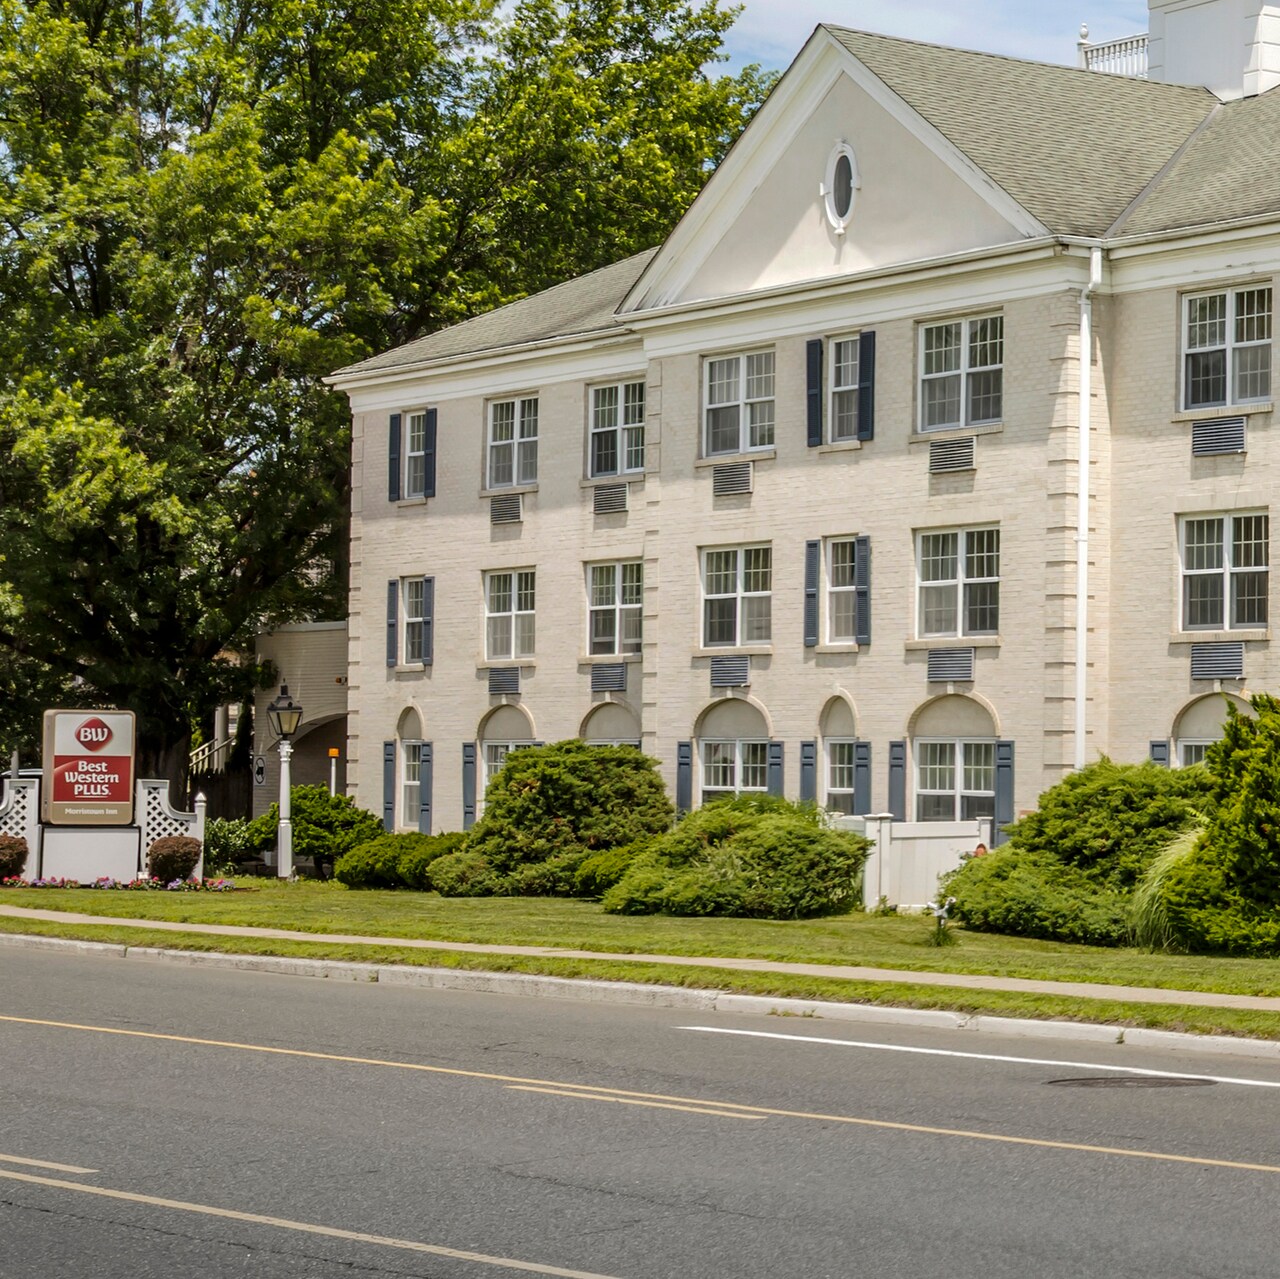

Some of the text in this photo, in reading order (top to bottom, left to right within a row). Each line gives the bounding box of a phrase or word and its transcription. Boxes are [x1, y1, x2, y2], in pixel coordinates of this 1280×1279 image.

[80, 727, 109, 742] BW
[78, 760, 108, 773] Best
[65, 772, 119, 784] Western
[74, 784, 110, 796] PLUS
[64, 807, 105, 815] Morristown
